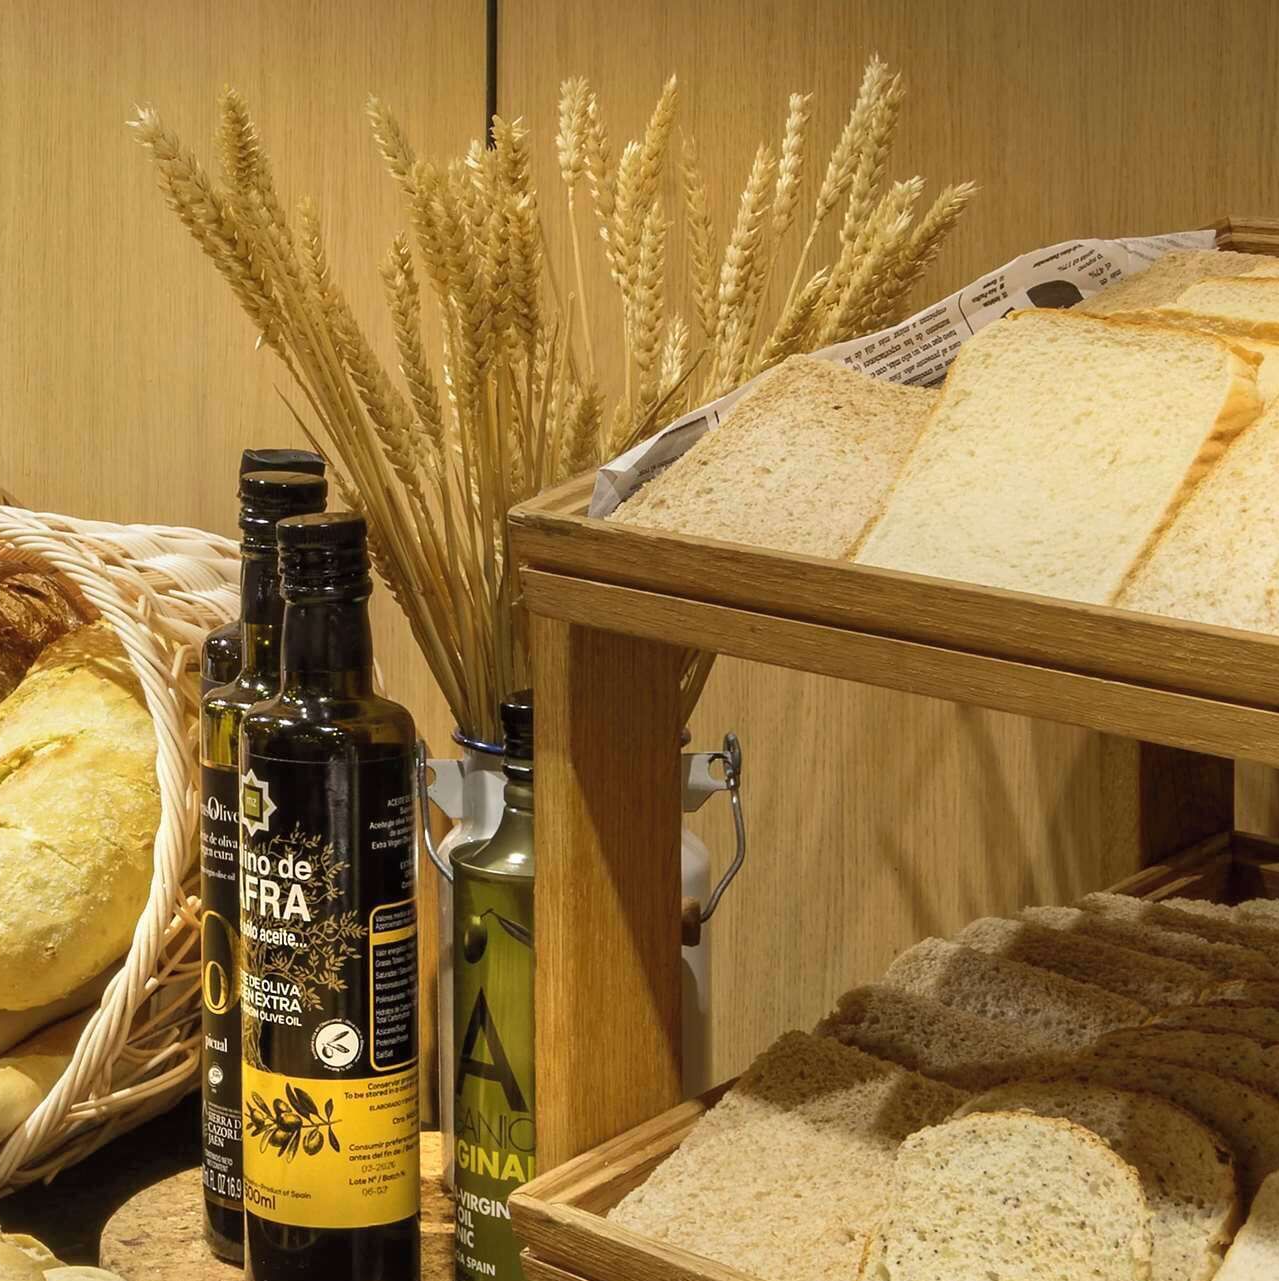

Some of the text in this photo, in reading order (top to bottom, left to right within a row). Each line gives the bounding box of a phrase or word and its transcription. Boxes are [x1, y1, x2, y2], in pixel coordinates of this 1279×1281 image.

[218, 834, 238, 848] oliva
[278, 854, 312, 881] de
[260, 928, 308, 948] aceite...
[261, 979, 301, 998] OLIVA
[255, 993, 302, 1013] EXTRA
[260, 1010, 285, 1024] OLIVE
[285, 1015, 302, 1027] OIL
[205, 1033, 228, 1053] picual
[455, 986, 529, 1113] A
[344, 1092, 354, 1100] To
[354, 1091, 364, 1099] be
[366, 1088, 388, 1098] stored
[367, 1079, 400, 1091] Conservar
[208, 1111, 232, 1128] SIERRA
[208, 1121, 242, 1141] CAZORL
[349, 1142, 385, 1152] Consumir
[349, 1153, 371, 1162] antes
[372, 1151, 383, 1160] del
[384, 1150, 393, 1158] fin
[349, 1178, 367, 1186] Lote
[290, 1190, 312, 1200] Spain
[457, 1205, 475, 1229] OIL
[466, 1256, 496, 1277] SPAIN
